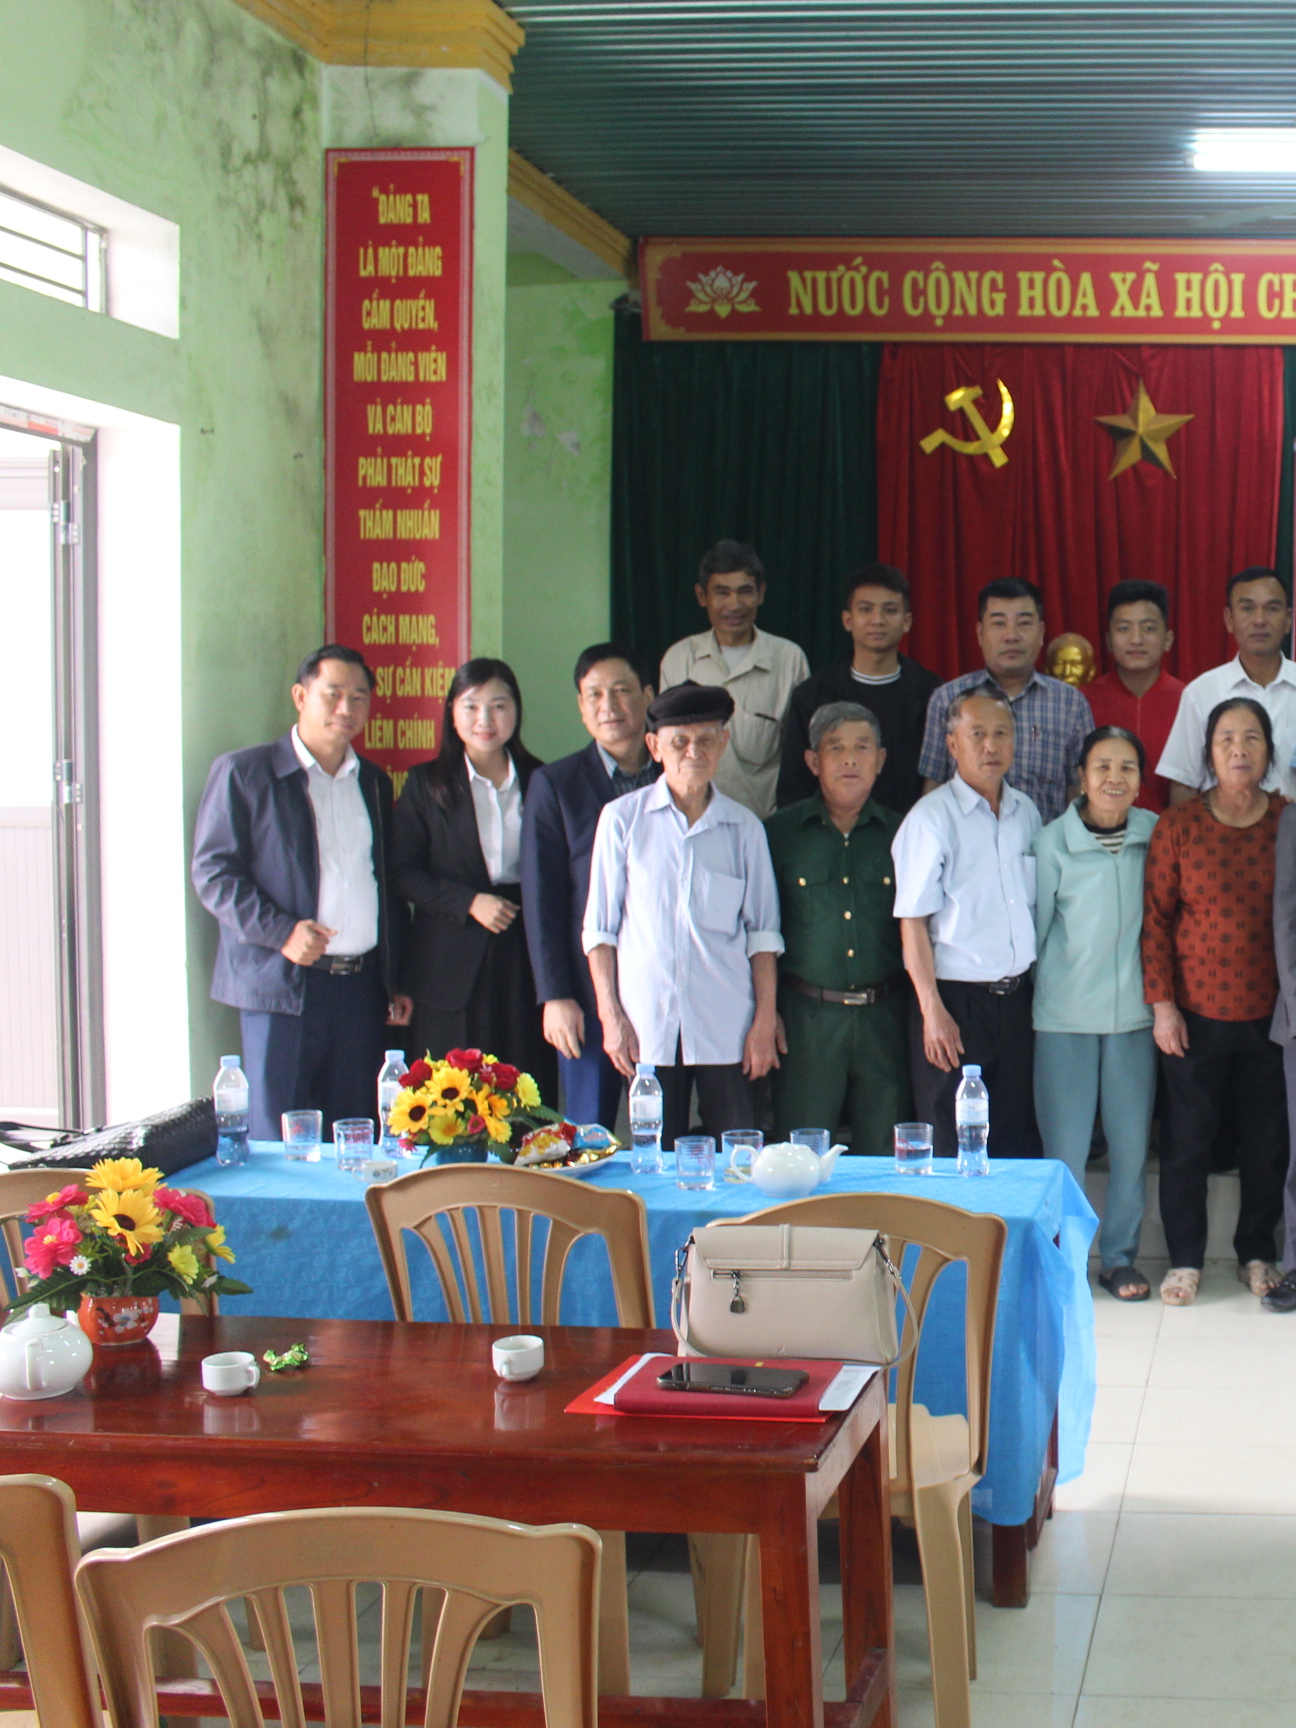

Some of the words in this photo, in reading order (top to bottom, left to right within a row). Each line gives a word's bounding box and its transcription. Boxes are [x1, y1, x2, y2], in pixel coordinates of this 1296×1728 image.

[416, 194, 431, 224] TA
[359, 240, 375, 277] LÀ
[378, 240, 405, 283] MỘT
[407, 236, 442, 277] ĐẢNG
[788, 256, 890, 315] NƯỚC
[902, 262, 1006, 327] CỘNG
[1017, 258, 1099, 316] HÒA
[1110, 261, 1164, 317] XÃ
[1174, 263, 1244, 329] HỘI
[380, 342, 415, 381] ĐẢNG
[418, 345, 447, 381] VIÊN
[367, 398, 384, 434] VÀ
[387, 398, 412, 434] CÁN
[416, 397, 433, 441] BỘ
[358, 447, 388, 487] PHẢI
[391, 451, 420, 493] THẬT
[424, 454, 442, 493] SỰ
[372, 560, 397, 598] ĐẠO
[400, 554, 425, 592] ĐỨC
[363, 608, 395, 645] CÁCH
[376, 664, 393, 704] SỰ
[364, 714, 394, 749] LIÊM
[398, 713, 435, 749] CHÍNH
